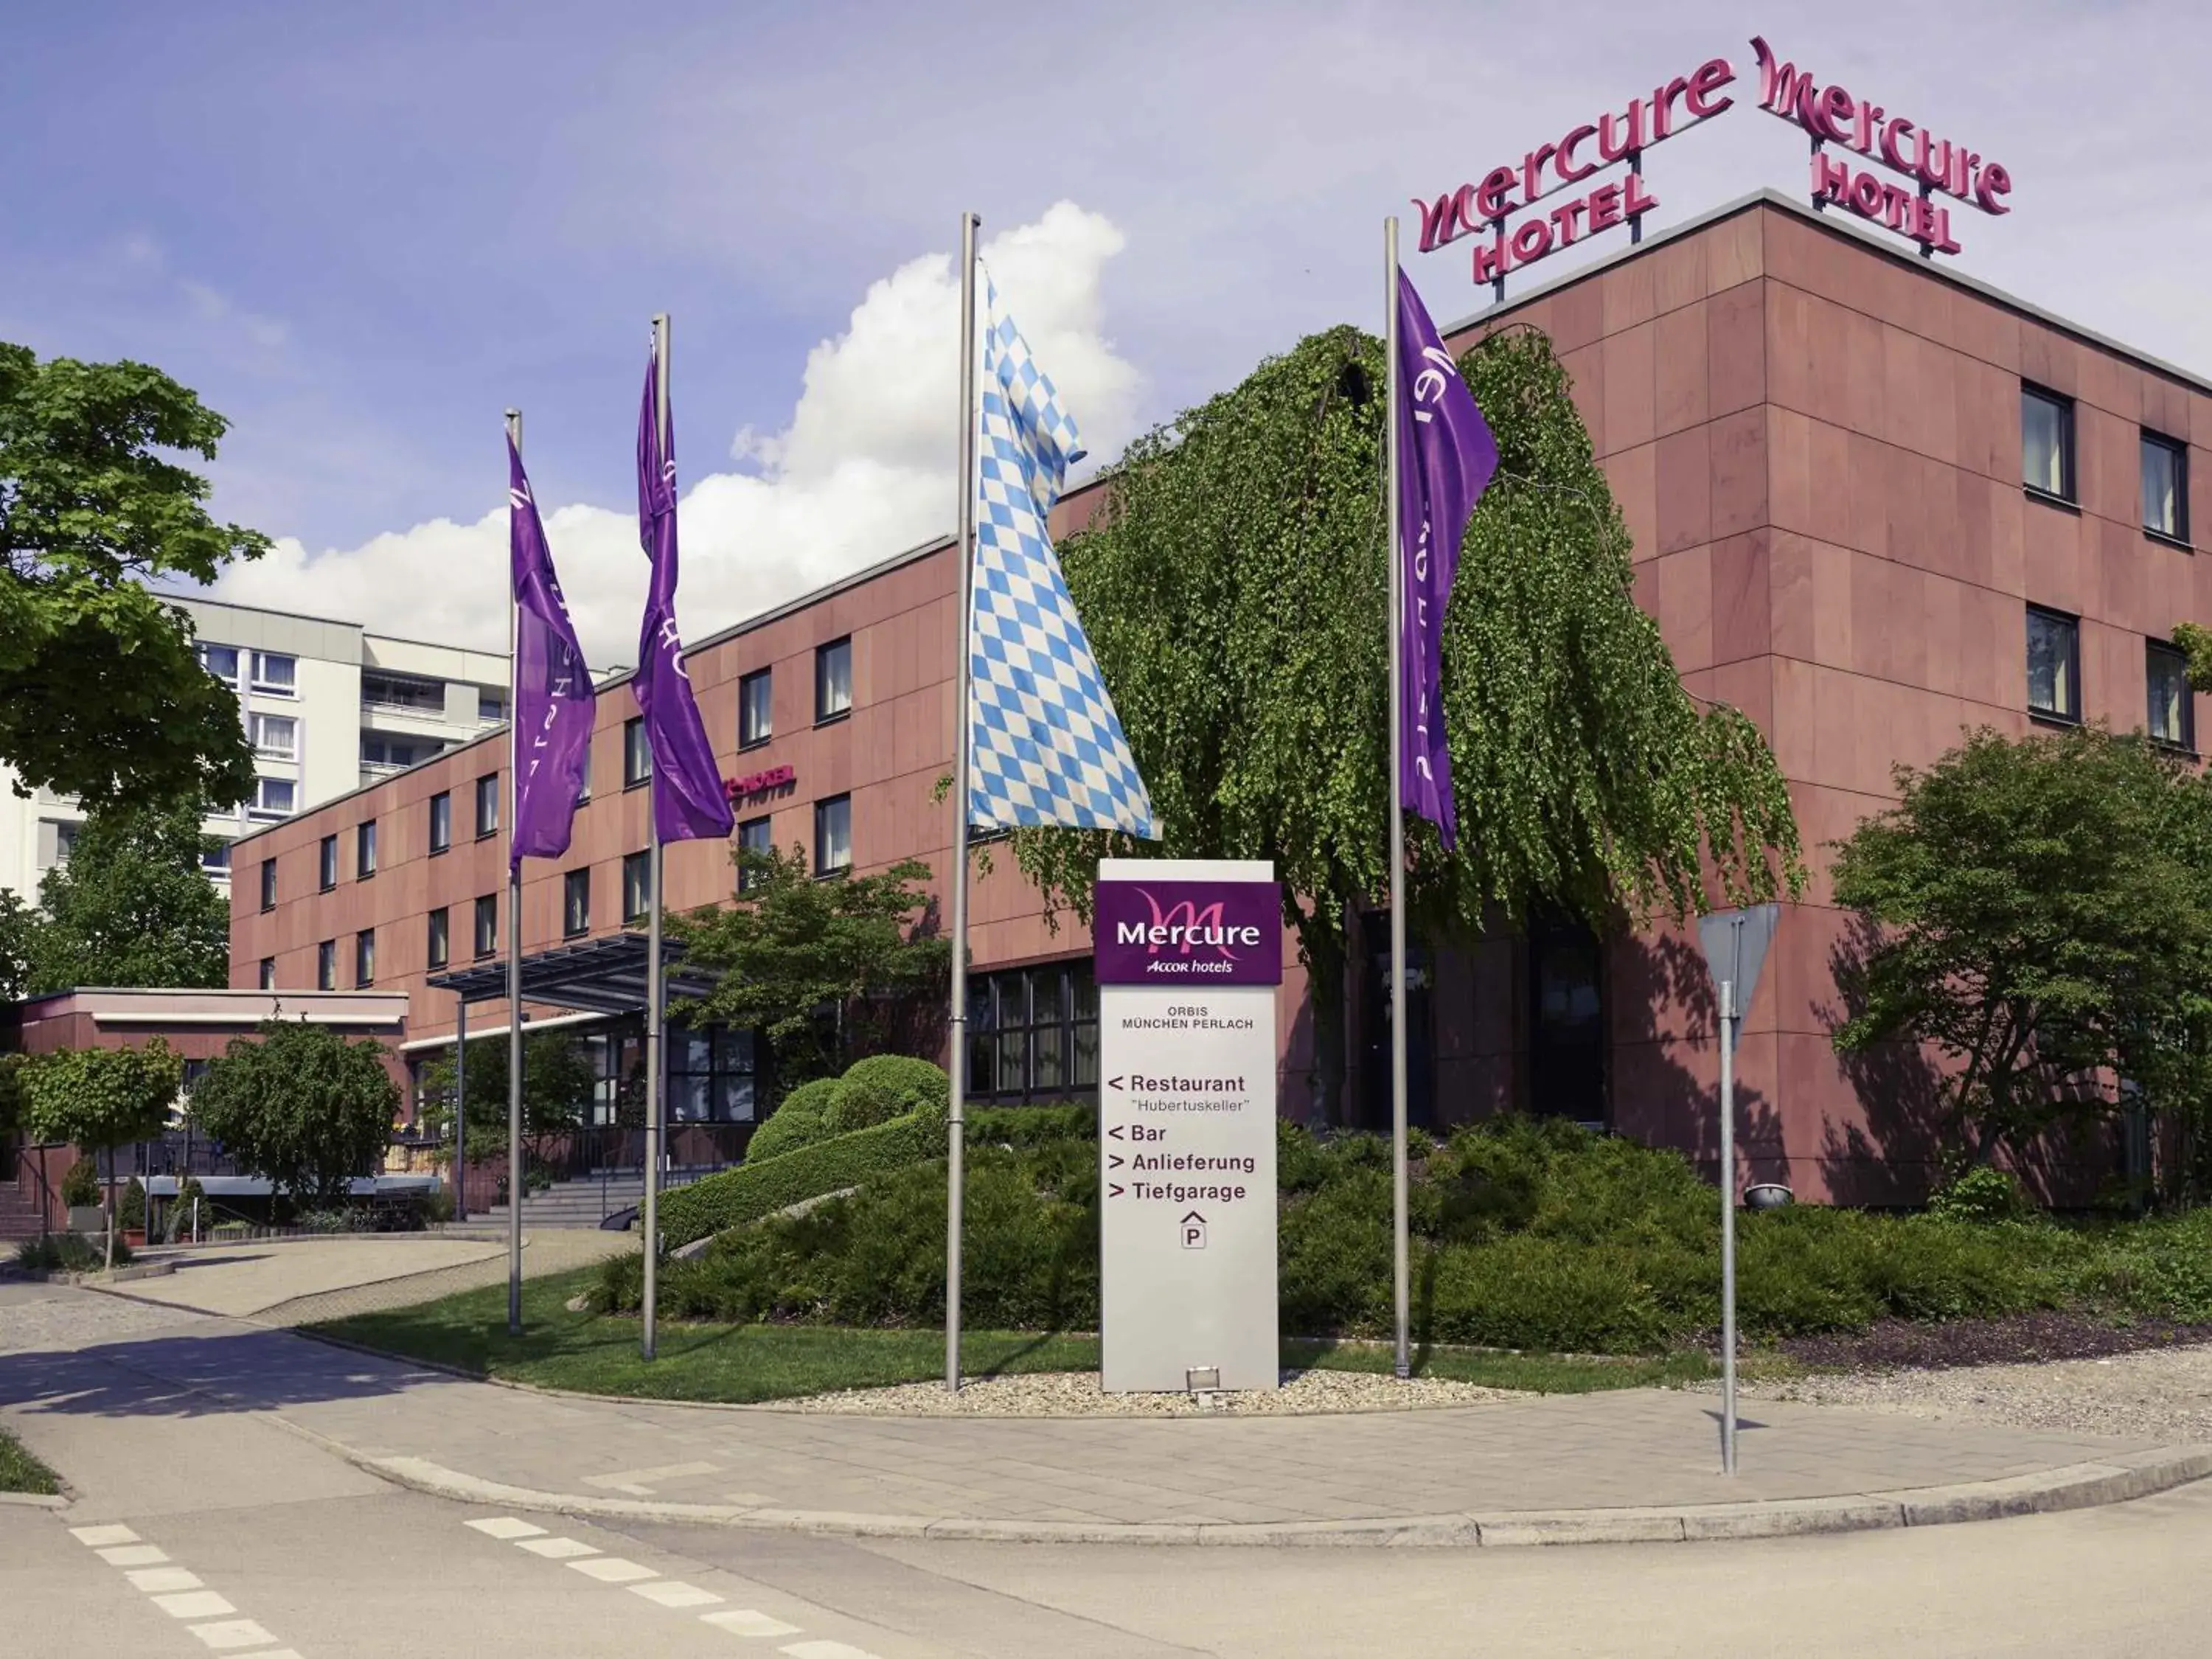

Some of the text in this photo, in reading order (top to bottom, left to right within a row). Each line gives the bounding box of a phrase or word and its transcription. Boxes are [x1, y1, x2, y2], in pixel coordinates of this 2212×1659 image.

[1812, 152, 1961, 254] HOTEL
[1472, 173, 1659, 285] HOTEL
[1117, 922, 1260, 945] Mercure
[1192, 959, 1233, 973] hotels
[1167, 1006, 1208, 1017] ORBIS
[1122, 1017, 1253, 1029] MÜNCHEN PERLACH
[1131, 1074, 1245, 1092] Restaurant
[1132, 1124, 1166, 1141] Bar
[1132, 1152, 1255, 1174] Anlieferung
[1132, 1182, 1246, 1203] Tiefgarage
[1186, 1228, 1200, 1245] P
